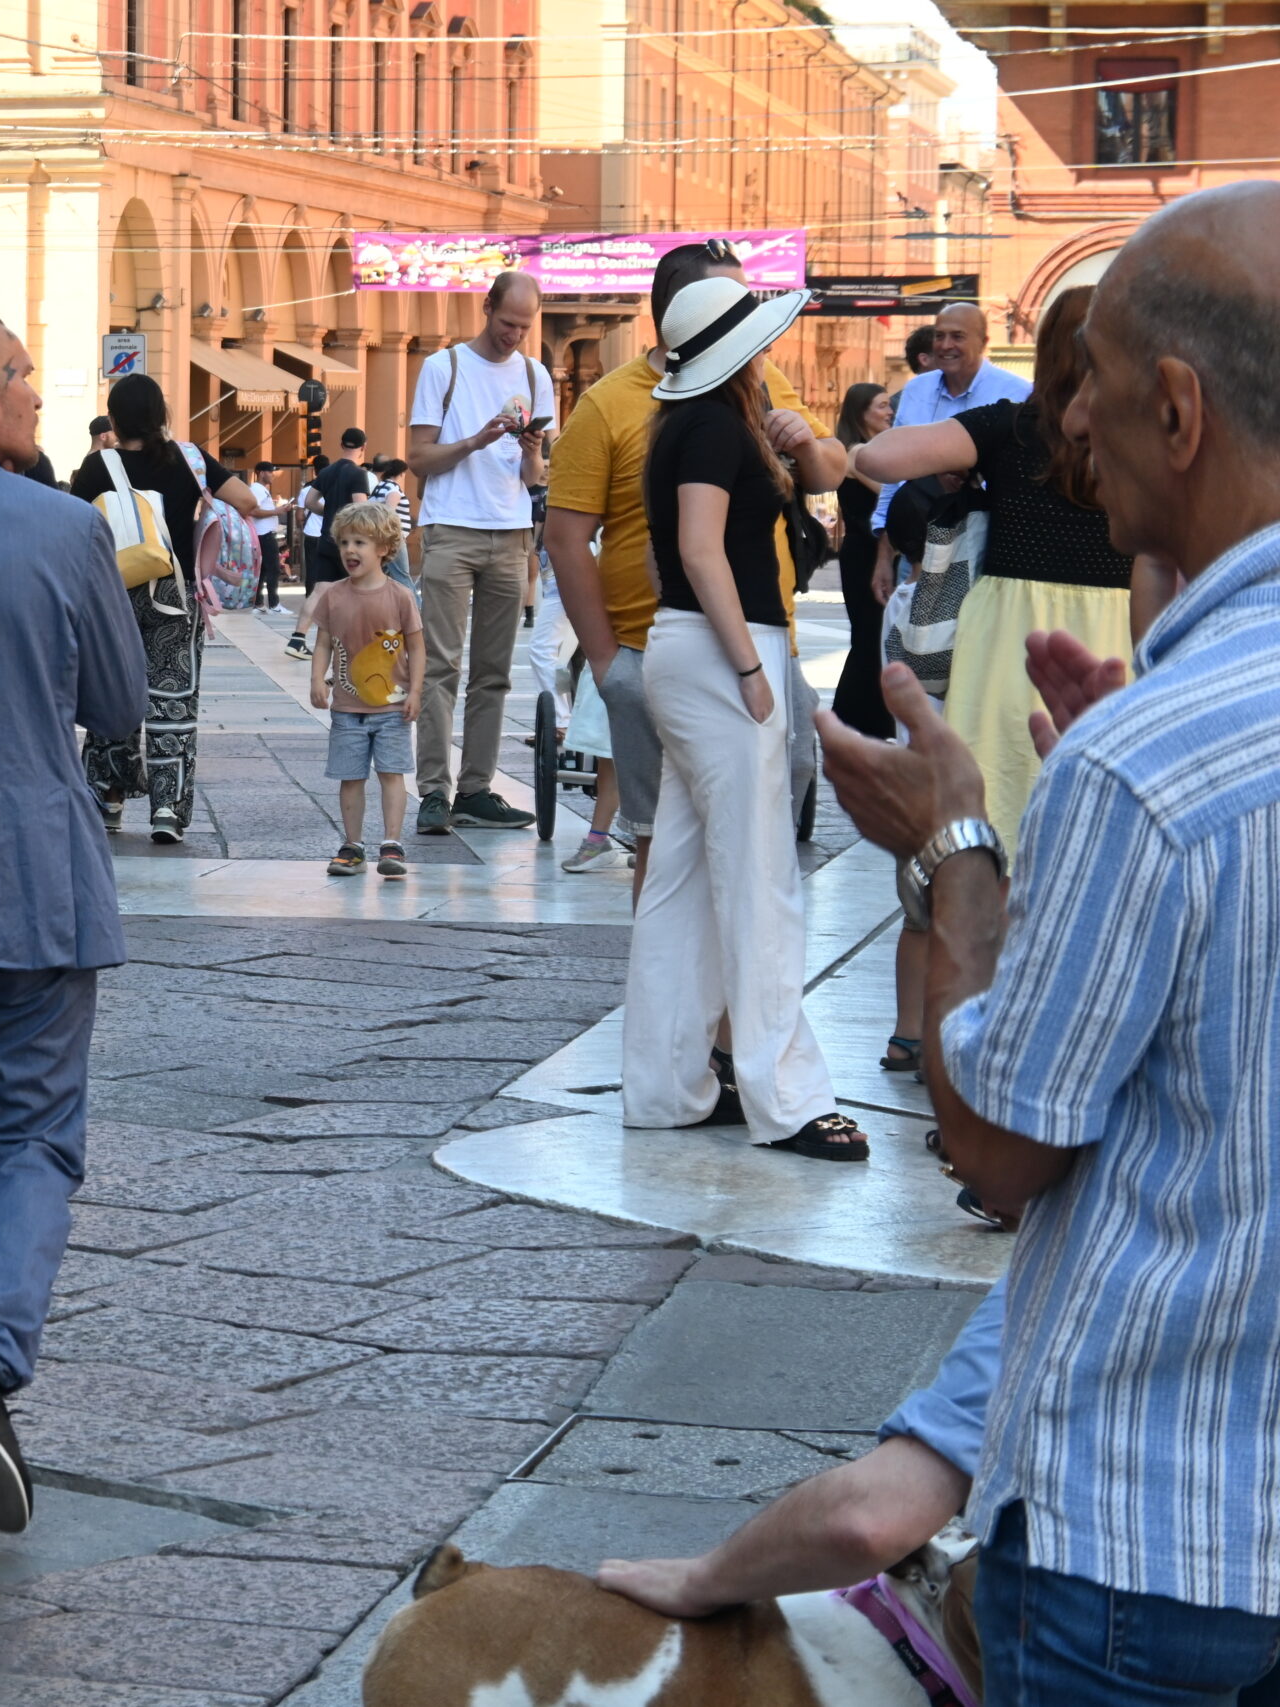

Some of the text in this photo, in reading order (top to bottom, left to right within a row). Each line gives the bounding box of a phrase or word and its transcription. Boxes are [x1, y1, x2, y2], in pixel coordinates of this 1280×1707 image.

[541, 240, 655, 257] Bologna Estate,
[539, 255, 596, 270] Cultura
[540, 273, 552, 284] 17
[552, 274, 596, 288] maggio
[241, 391, 281, 403] McDonald's
